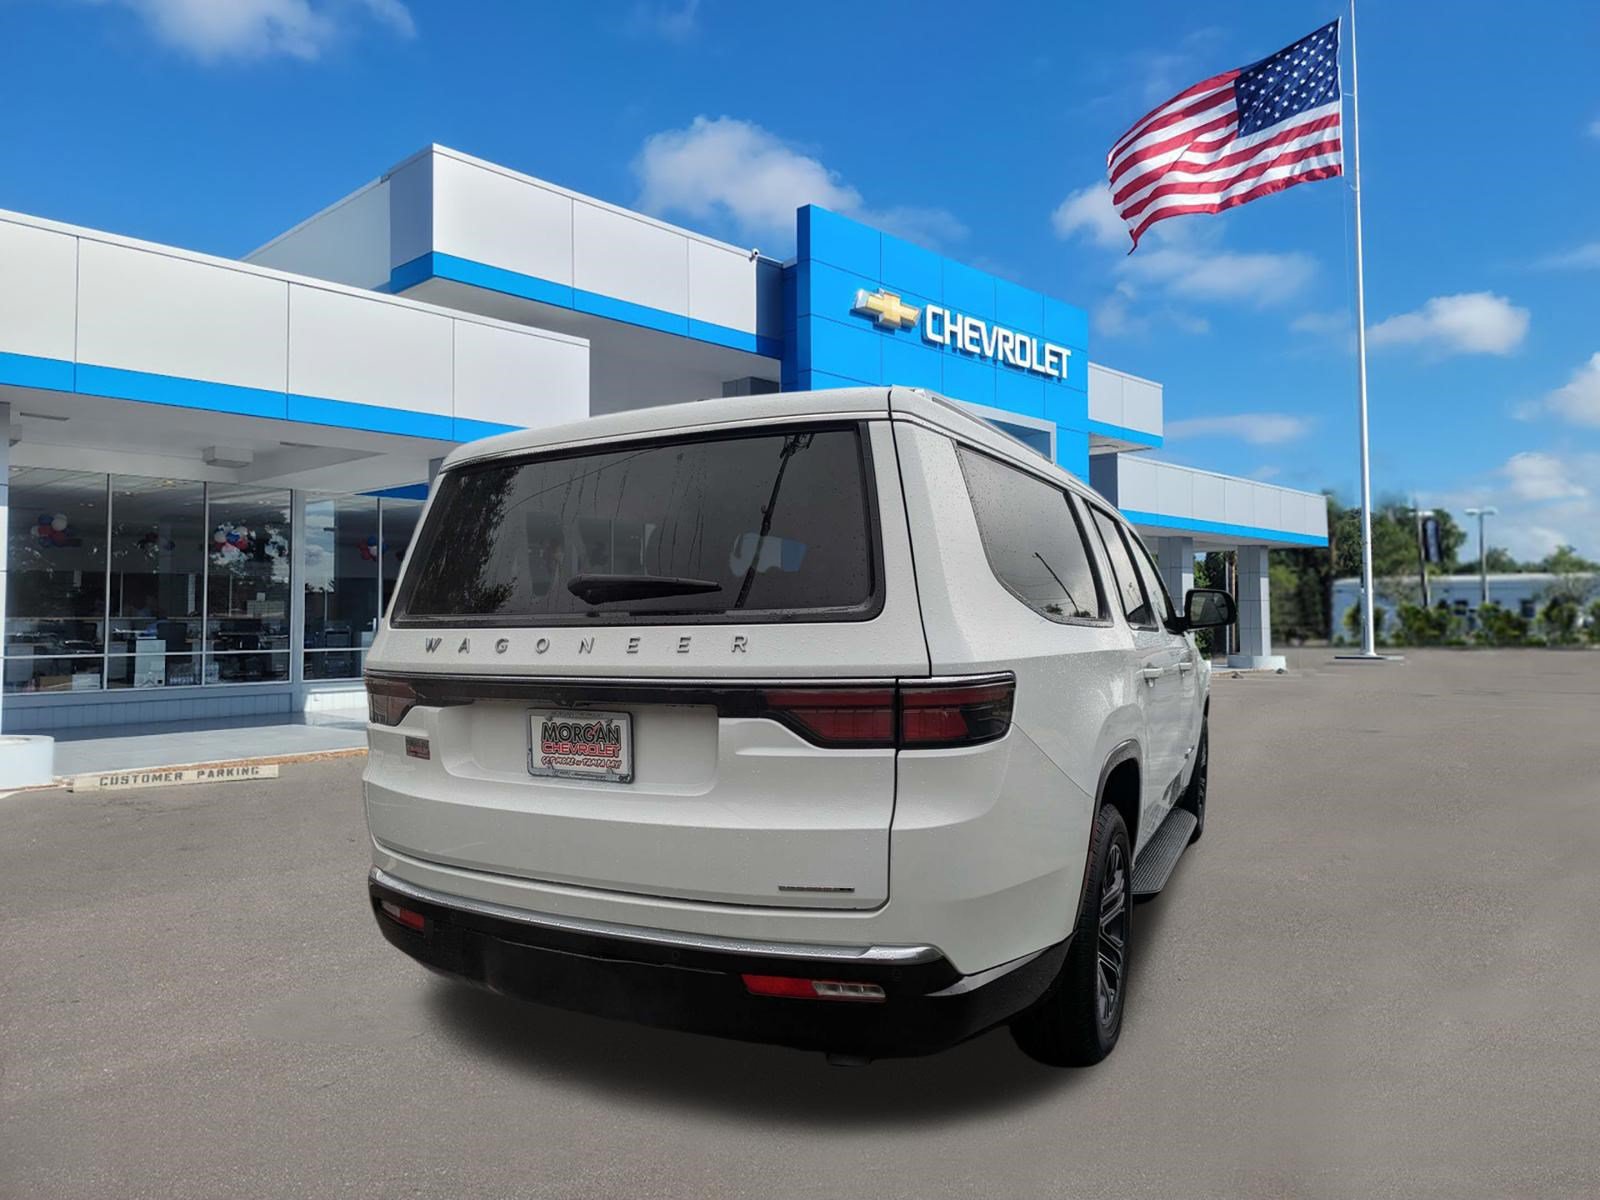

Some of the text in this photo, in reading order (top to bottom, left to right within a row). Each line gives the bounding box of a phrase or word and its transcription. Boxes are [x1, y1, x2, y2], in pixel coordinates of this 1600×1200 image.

[923, 304, 1072, 379] CHEVROLET
[425, 637, 748, 654] WAGONEER
[541, 721, 621, 744] MORGAN
[541, 742, 621, 758] CHEVROLET
[100, 766, 259, 786] CUSTOMER PARKING
